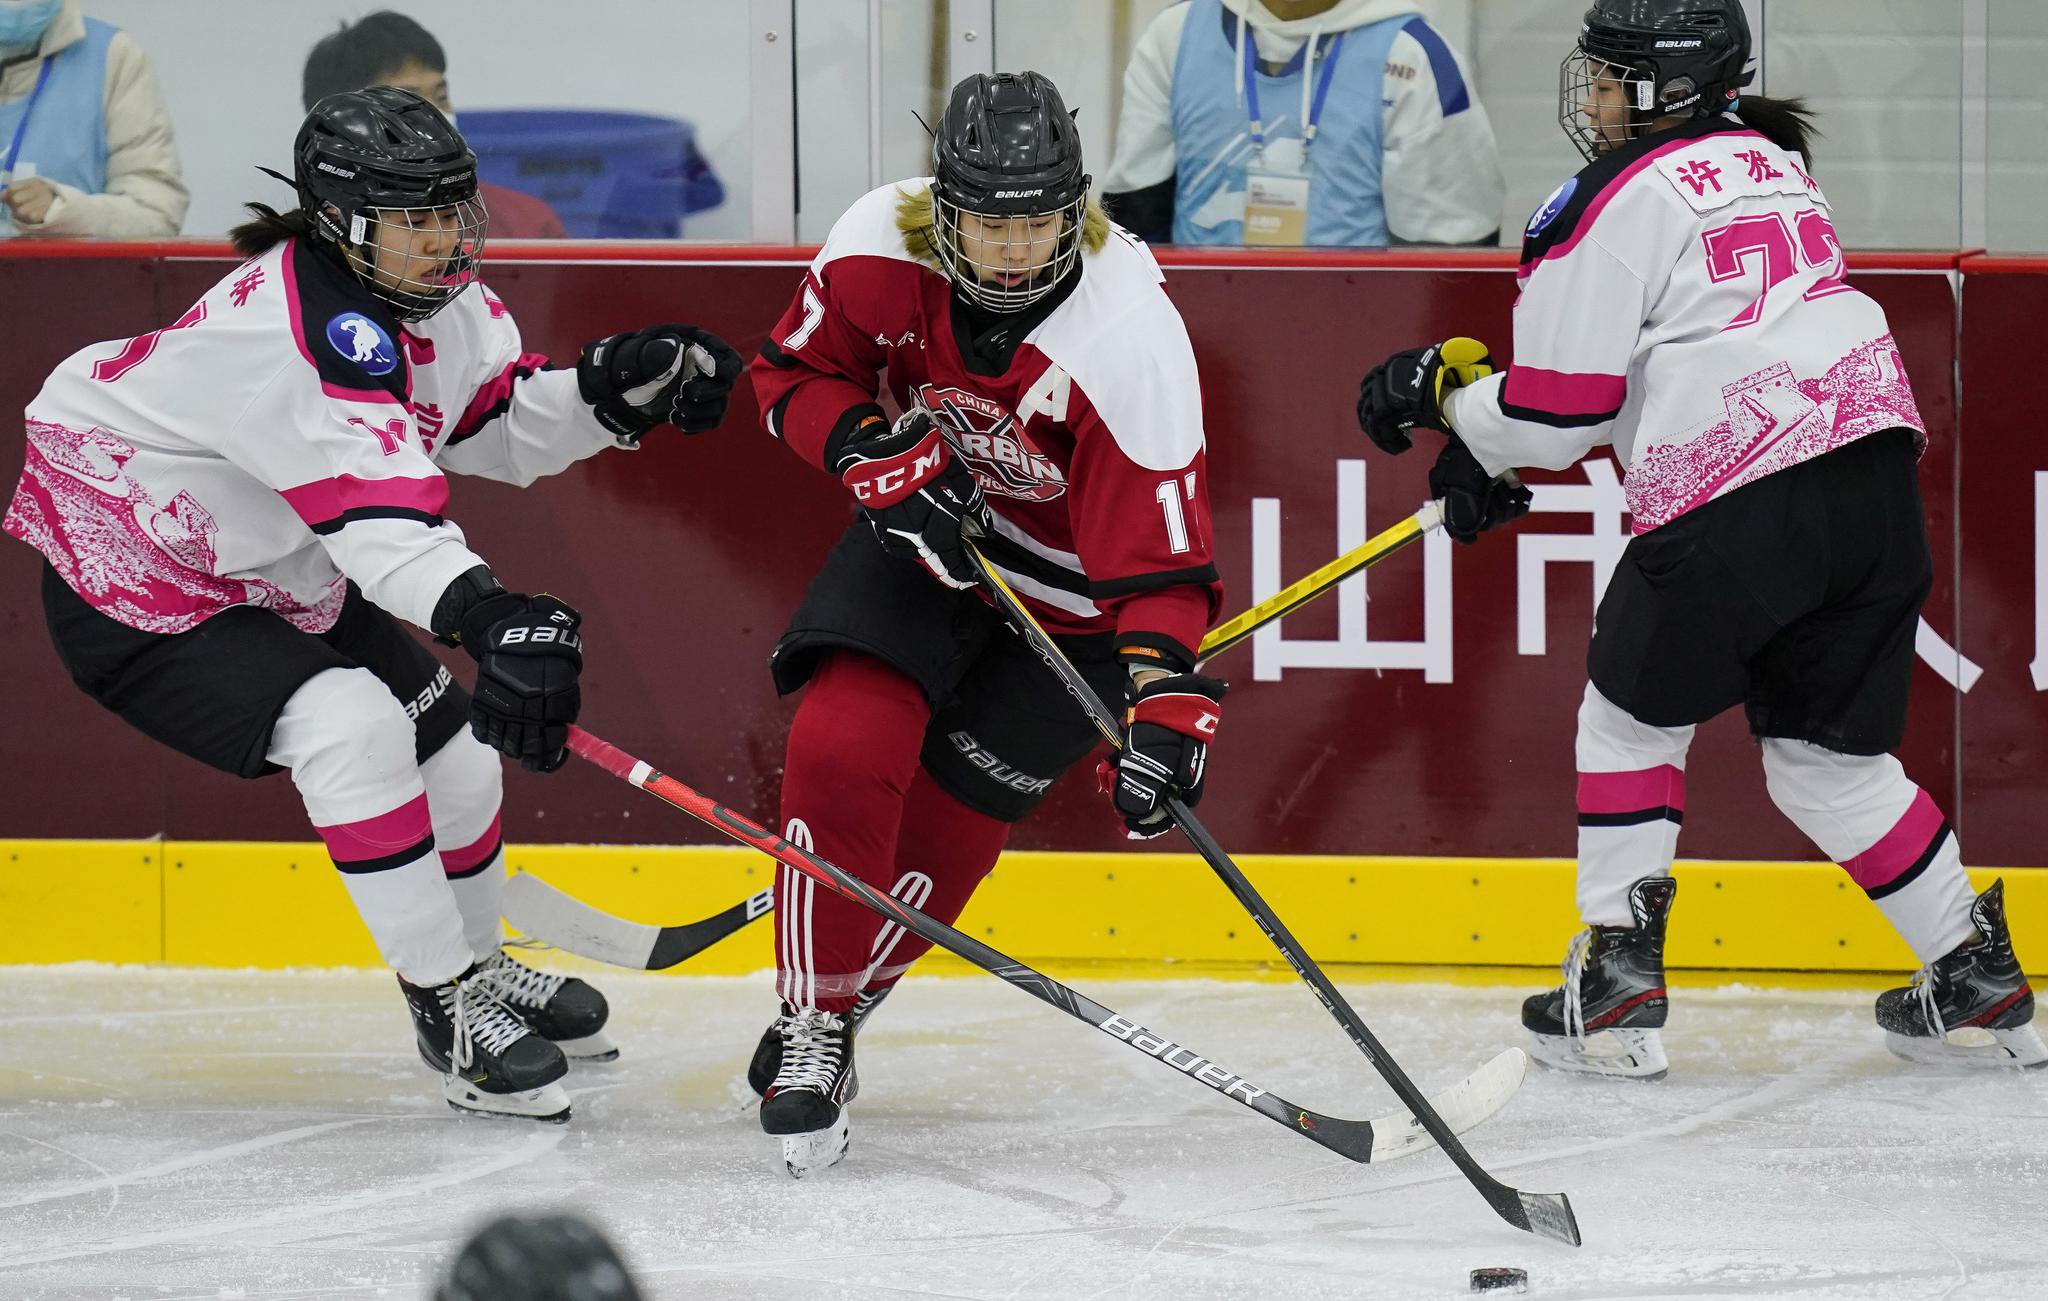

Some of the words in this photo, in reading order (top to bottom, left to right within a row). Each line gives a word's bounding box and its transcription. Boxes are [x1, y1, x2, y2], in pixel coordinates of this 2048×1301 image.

[994, 188, 1043, 199] BAUER
[956, 393, 1000, 417] CHINA
[1016, 362, 1071, 427] A
[852, 442, 941, 500] CCM
[961, 433, 1064, 482] RBIN
[1098, 1013, 1267, 1106] BAUER
